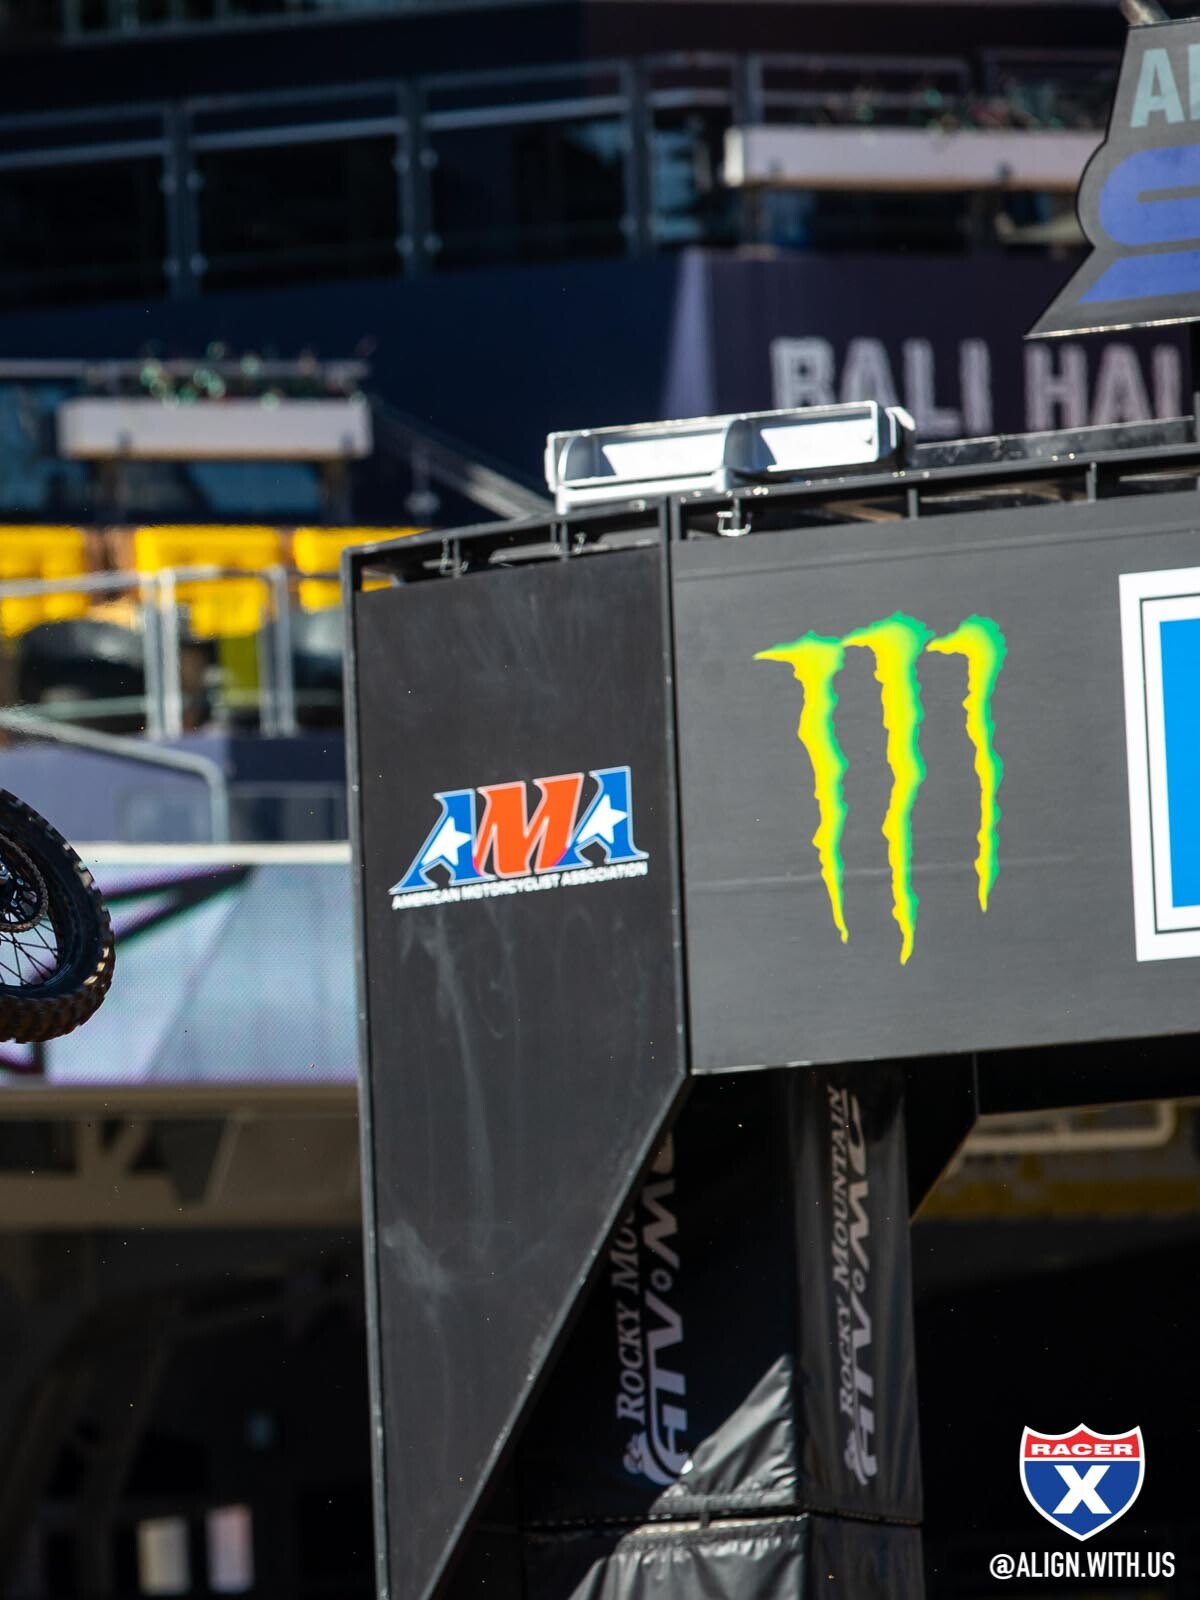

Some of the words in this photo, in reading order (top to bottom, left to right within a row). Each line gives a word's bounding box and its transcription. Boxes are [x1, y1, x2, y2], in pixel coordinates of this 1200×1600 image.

[770, 336, 994, 438] BALI
[1023, 342, 1183, 433] HAI
[388, 765, 650, 895] AMA
[392, 885, 461, 911] AMERICAN
[461, 872, 560, 901] MOTORCYCLIST
[560, 861, 649, 887] ASSOCIATION
[827, 1083, 850, 1290] MOUNTAIN
[615, 1298, 646, 1425] ROCKY
[836, 1297, 856, 1418] ROCKY
